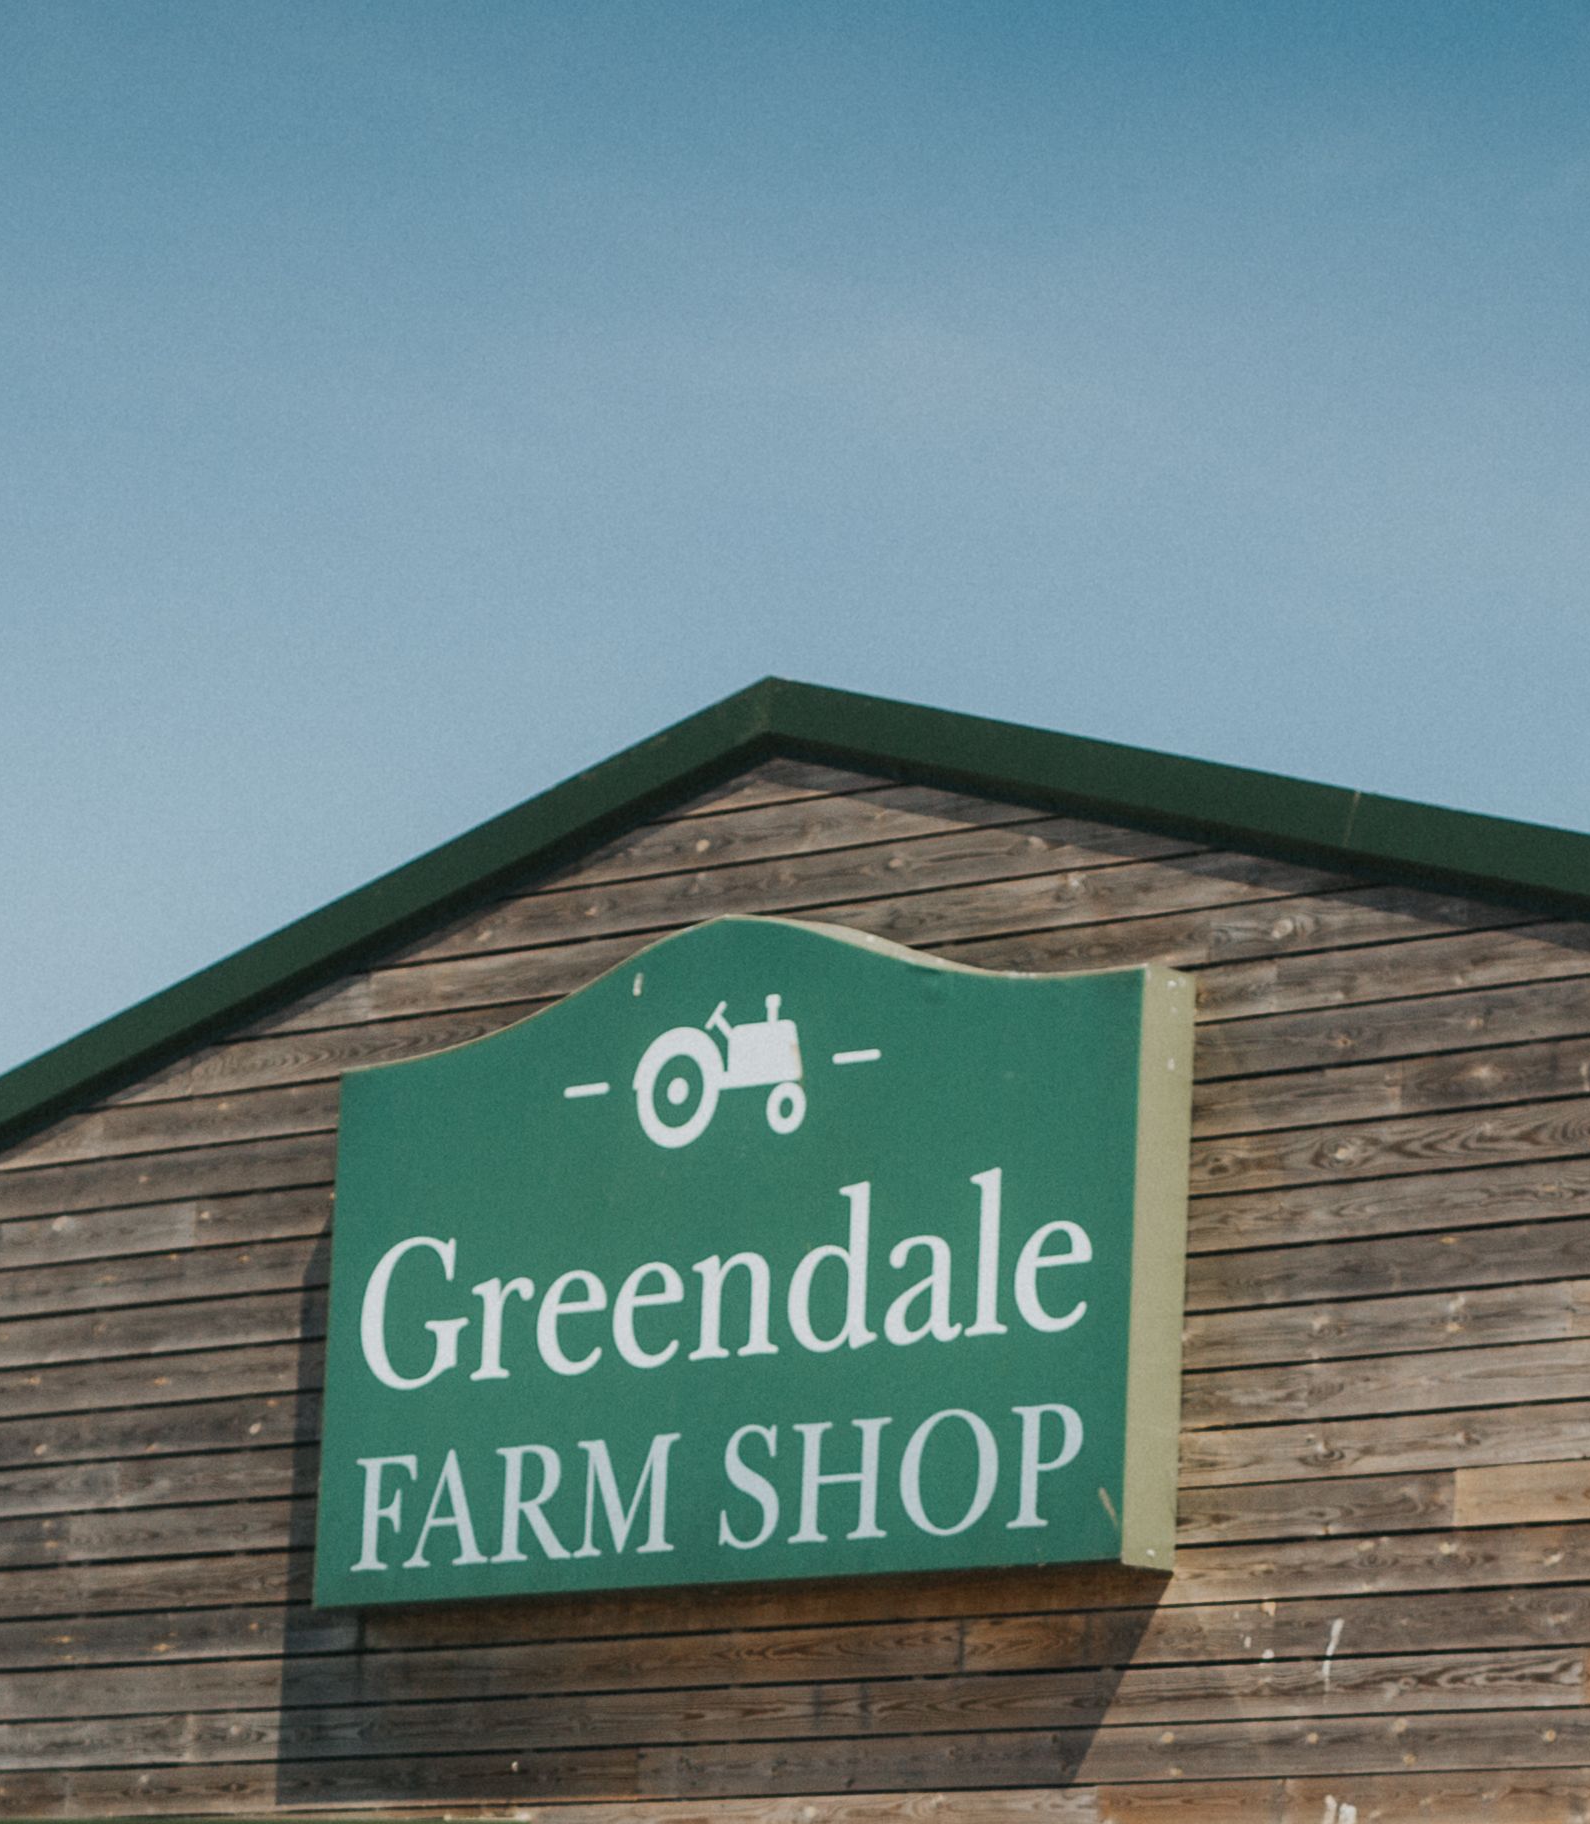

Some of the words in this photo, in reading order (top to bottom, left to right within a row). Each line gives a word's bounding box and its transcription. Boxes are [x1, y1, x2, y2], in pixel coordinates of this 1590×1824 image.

[359, 1166, 1094, 1391] Greendale
[350, 1432, 681, 1573] FARM
[718, 1403, 1084, 1550] SHOP
